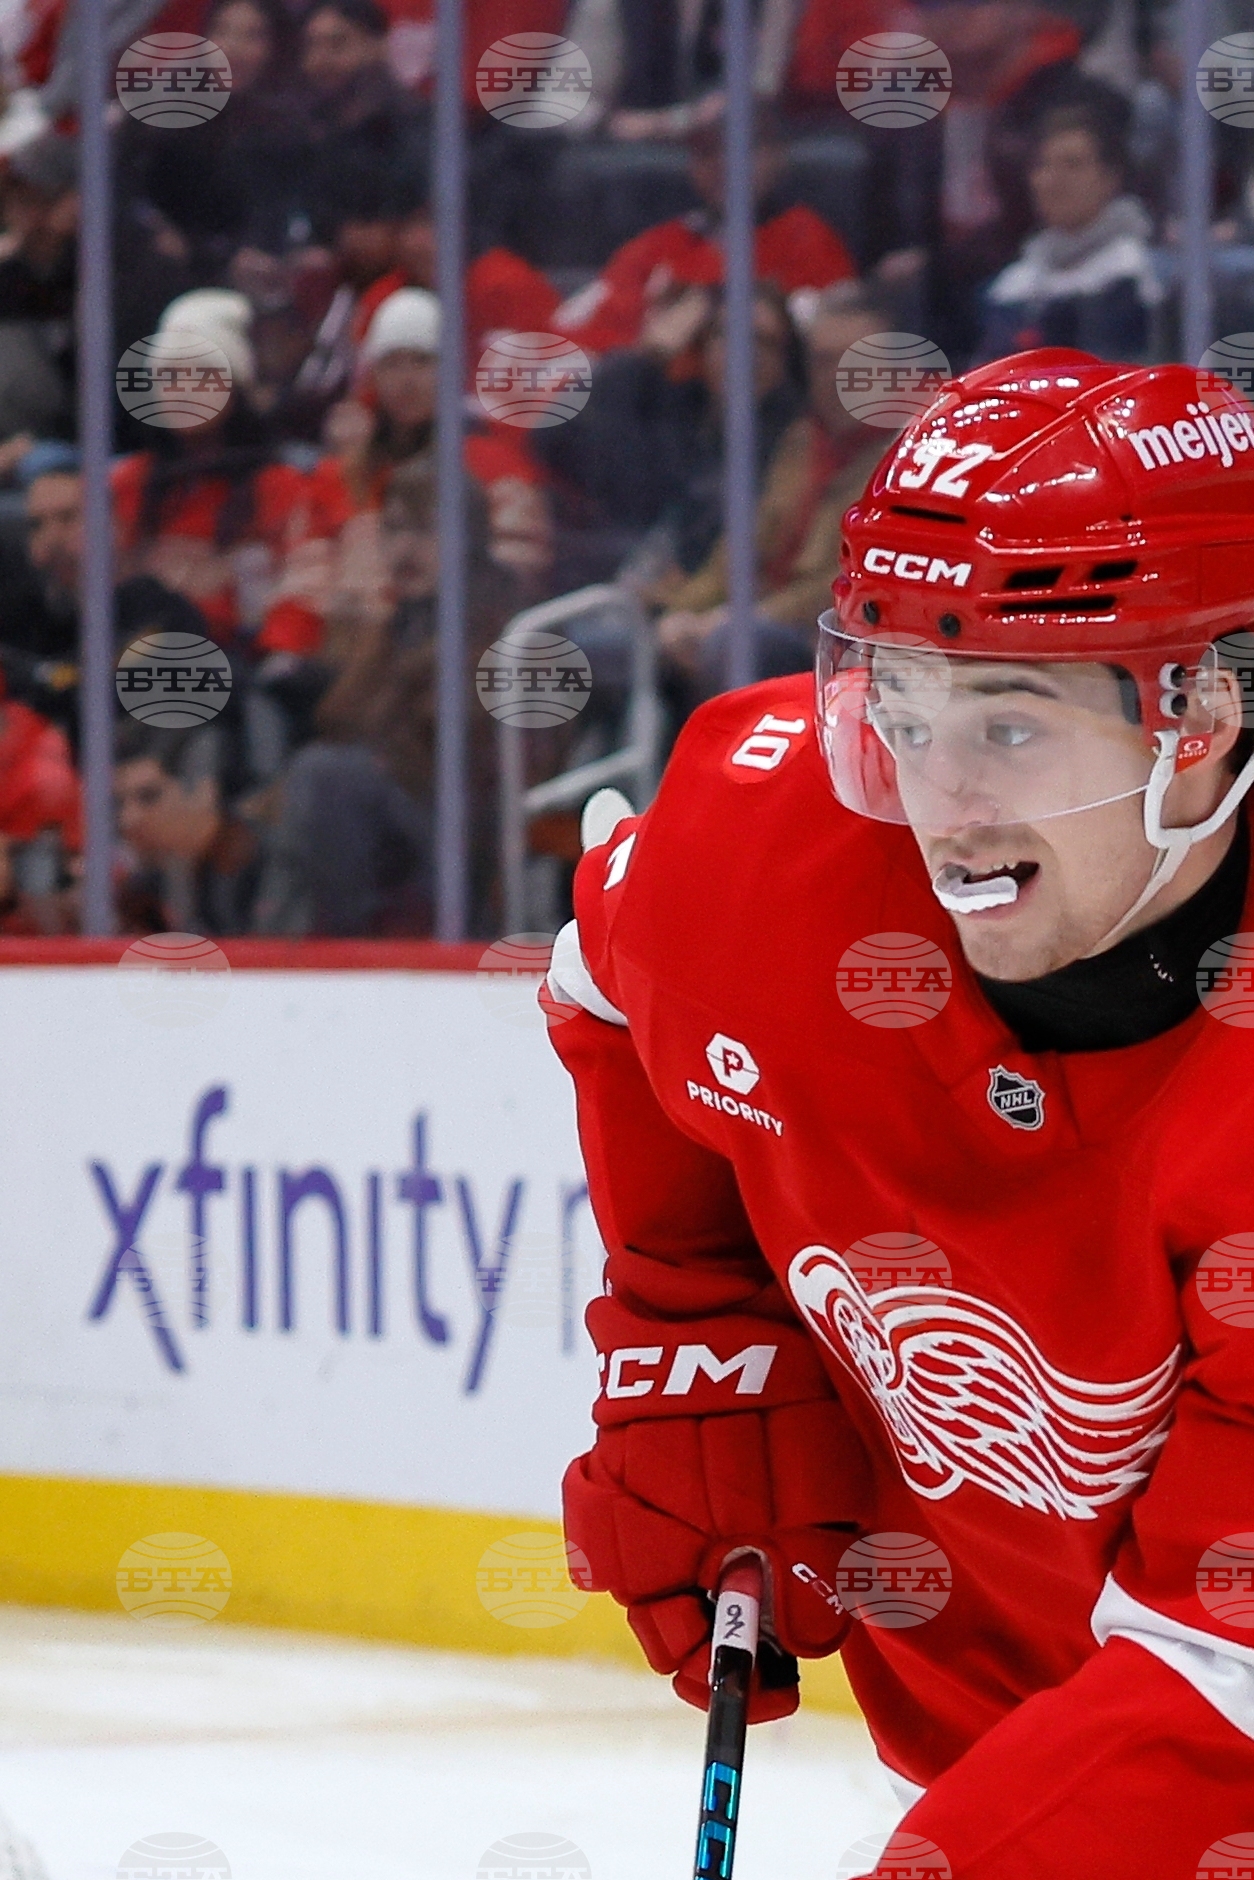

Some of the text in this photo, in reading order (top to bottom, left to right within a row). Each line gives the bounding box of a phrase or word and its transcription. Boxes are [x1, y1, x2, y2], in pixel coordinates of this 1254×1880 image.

[899, 437, 995, 498] 92
[863, 547, 972, 587] CCM
[731, 713, 806, 772] 10
[686, 1079, 783, 1137] PRIORITY
[1000, 1091, 1033, 1109] NHL
[86, 1079, 524, 1398] xfinity
[598, 1344, 778, 1400] CM
[791, 1562, 844, 1616] CCM
